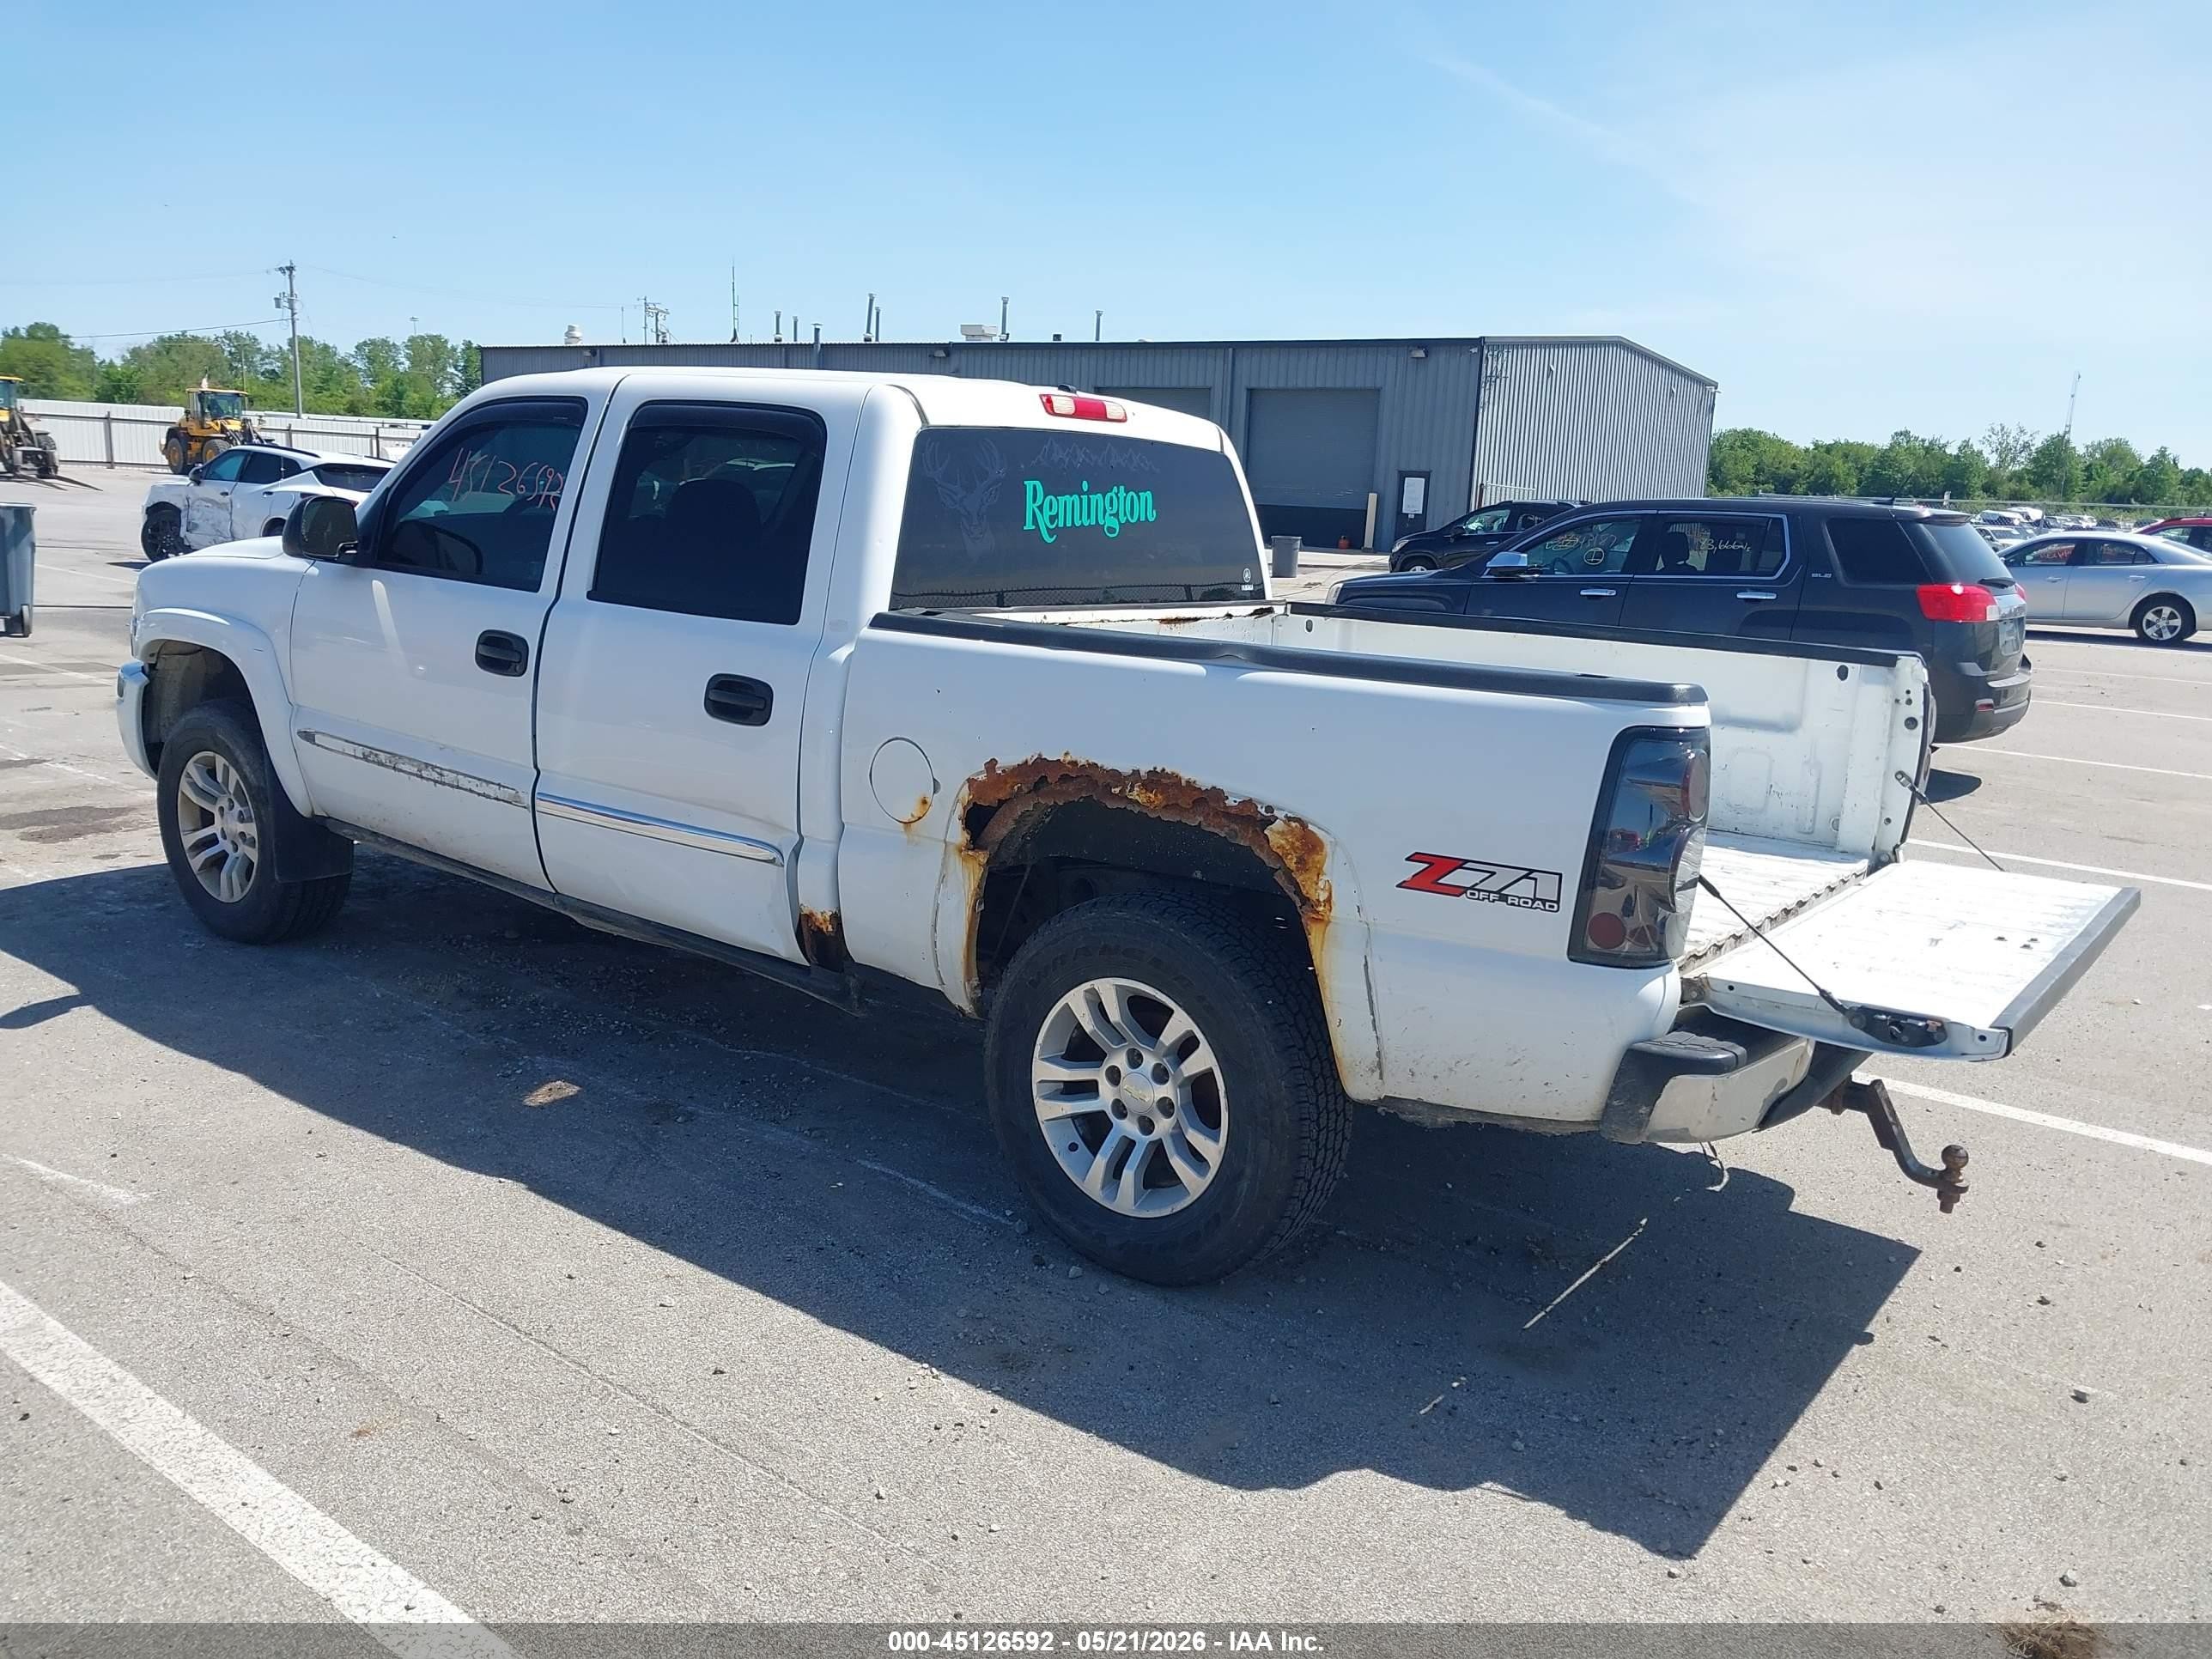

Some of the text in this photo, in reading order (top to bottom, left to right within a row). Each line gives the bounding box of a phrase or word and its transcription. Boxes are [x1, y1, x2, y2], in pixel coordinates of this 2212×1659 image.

[1022, 479, 1157, 544] Remington
[1395, 851, 1563, 902] Z71
[1465, 888, 1559, 912] OFF ROAD
